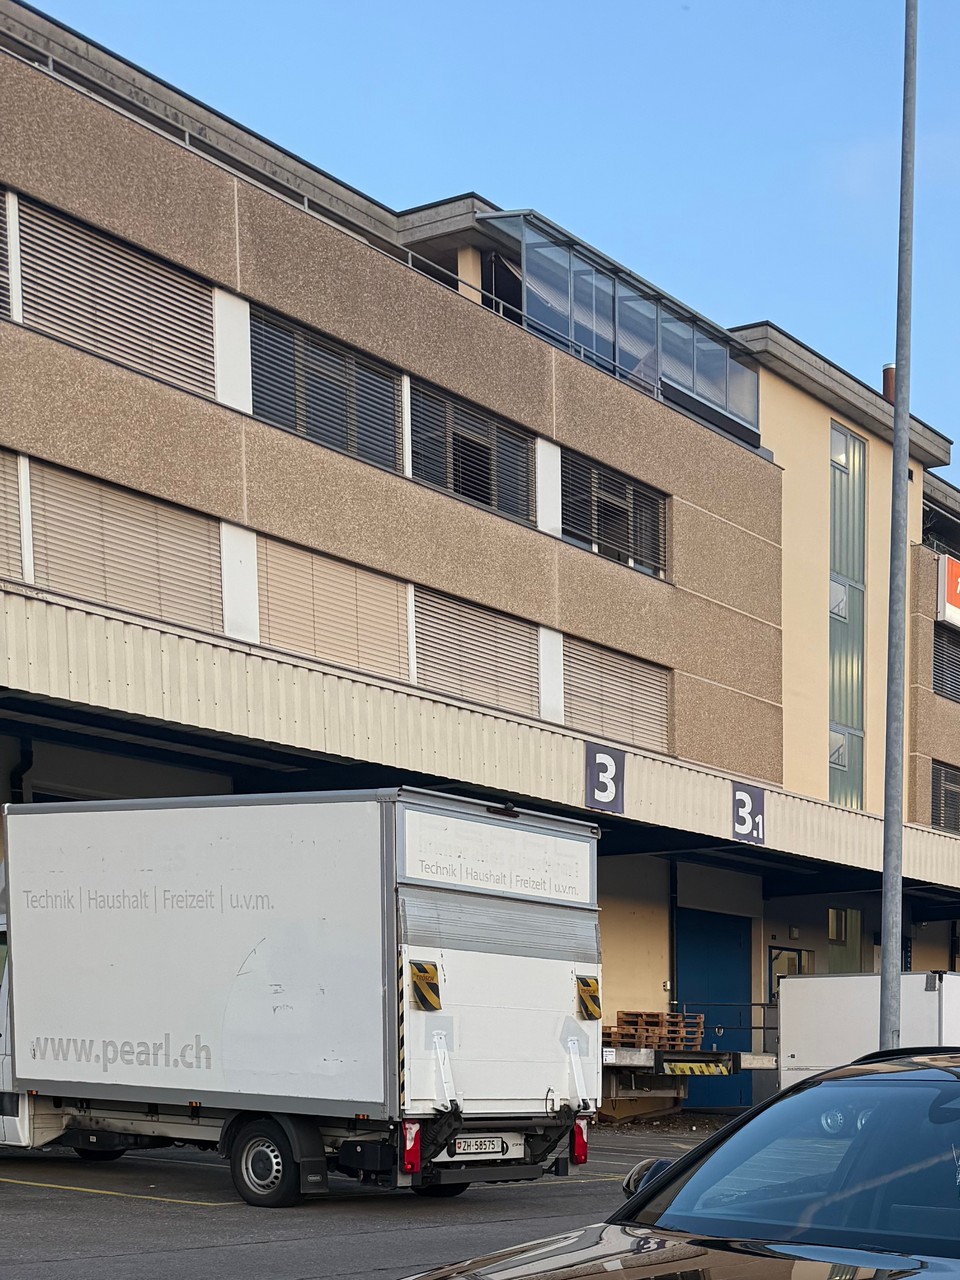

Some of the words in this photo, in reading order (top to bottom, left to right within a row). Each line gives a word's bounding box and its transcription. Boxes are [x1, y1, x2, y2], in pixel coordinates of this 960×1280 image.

[594, 753, 617, 803] 3
[419, 859, 457, 878] Technik
[465, 867, 507, 886] Haushalt
[515, 874, 547, 892] Freizeit
[554, 884, 579, 896] u.v.m.
[22, 889, 75, 910] Technik
[87, 888, 149, 910] Haushalt
[163, 889, 215, 910] Freizeit
[230, 893, 275, 911] u.v.m.
[31, 1033, 212, 1072] www.pearl.ch
